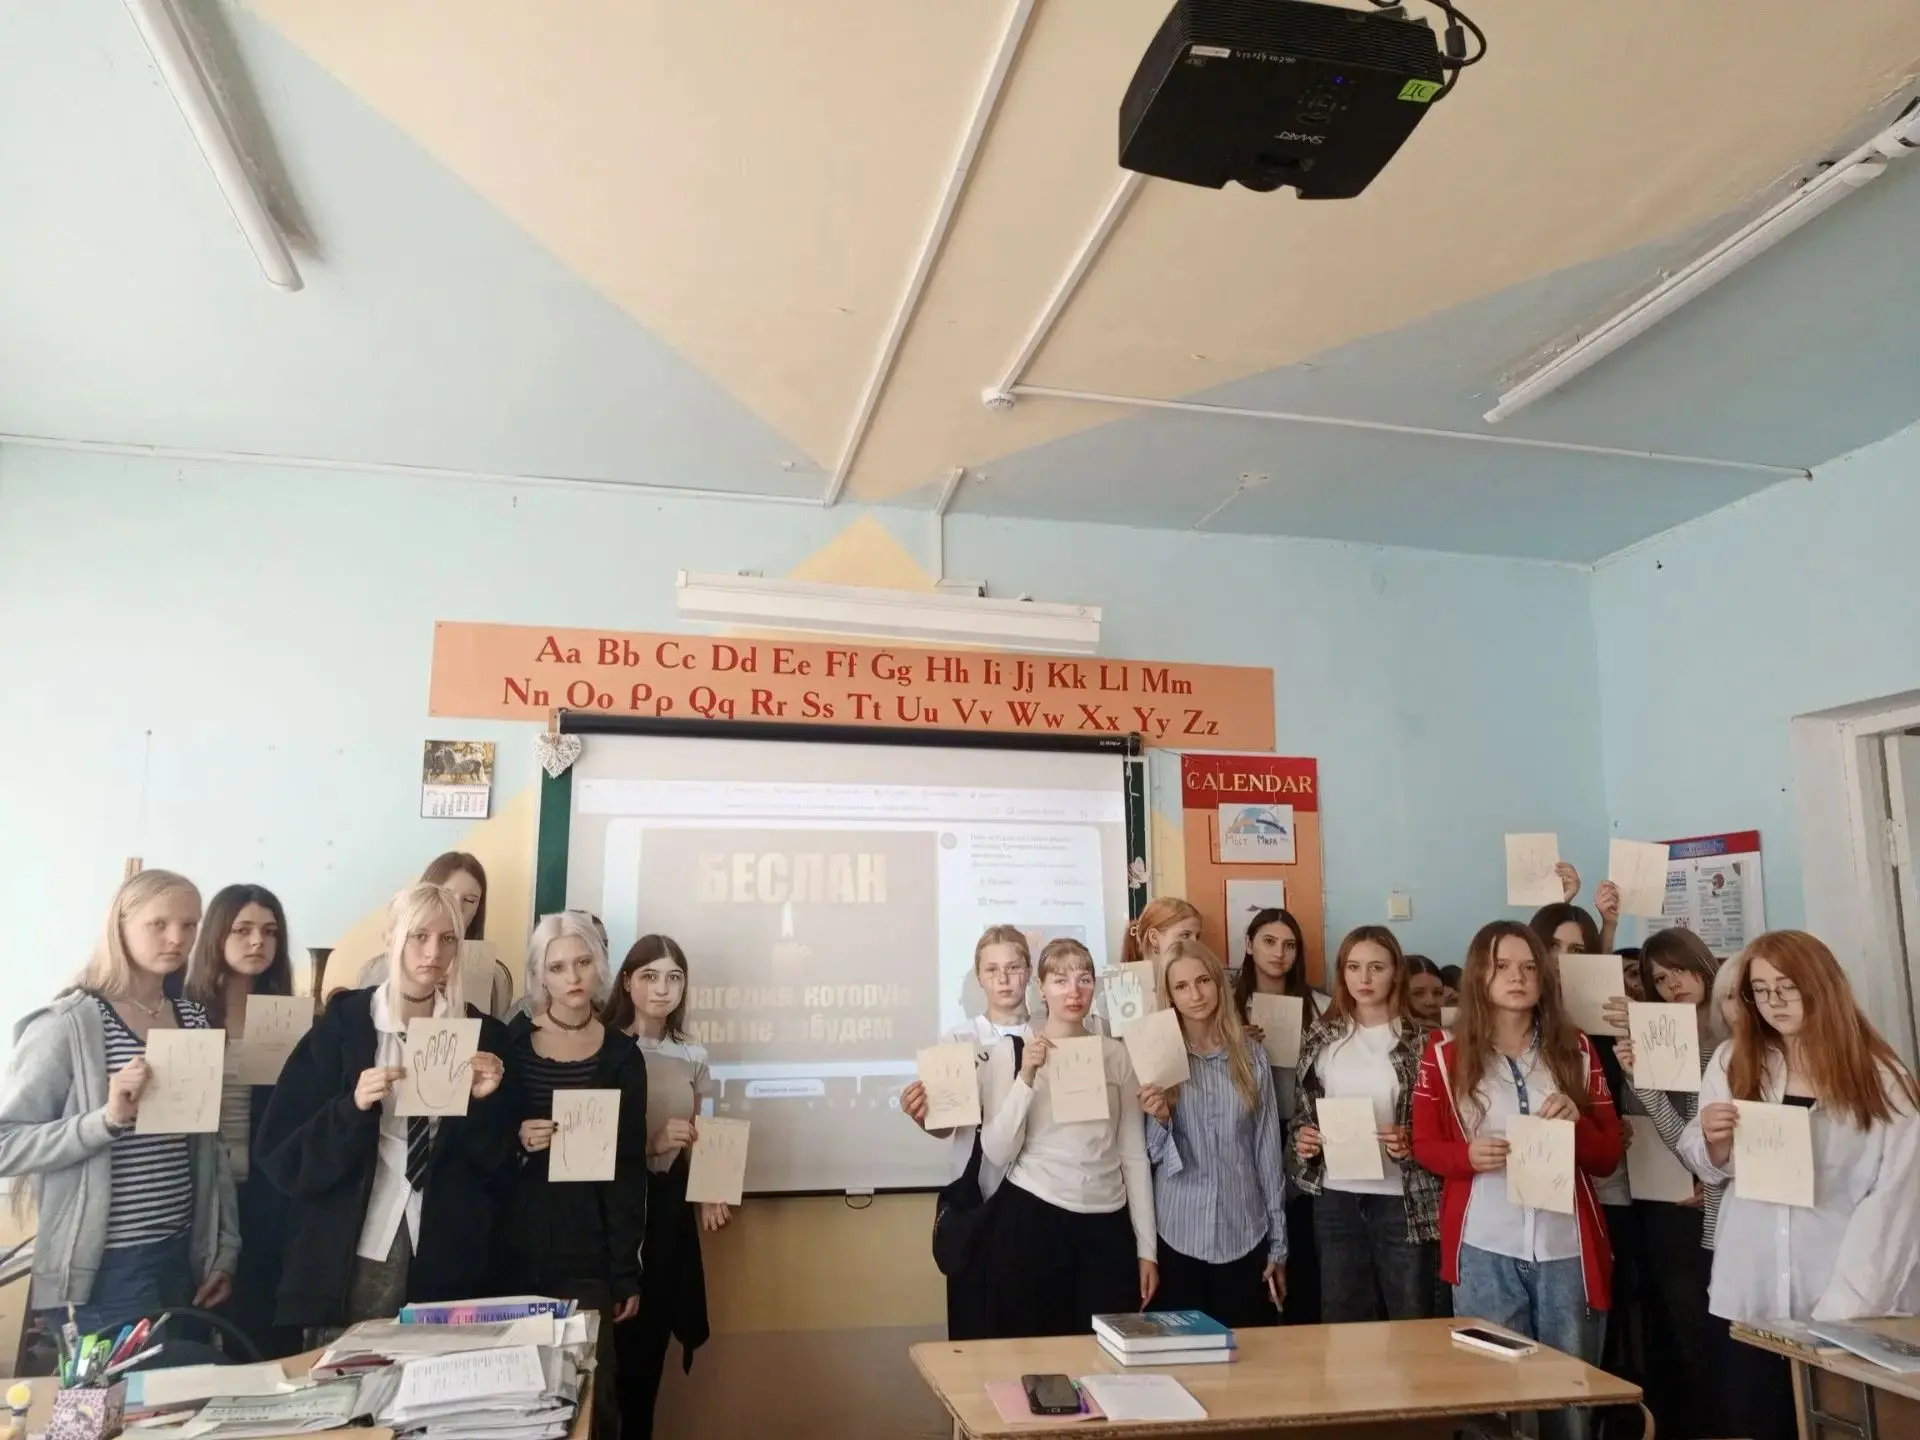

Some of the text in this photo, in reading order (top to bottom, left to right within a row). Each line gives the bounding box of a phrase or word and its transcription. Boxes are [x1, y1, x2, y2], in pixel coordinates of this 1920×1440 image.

[1274, 131, 1329, 145] SMART
[535, 635, 1193, 695] Aa Bb Cc Dd Ee Ff Gg Hh Ii Jj Kk Ll Mm
[503, 677, 1219, 738] Nn Oo Pp Qq Rr Ss Tt Uu Vv Ww Xx Yy Zz
[1186, 771, 1313, 794] CALENDAR
[697, 852, 888, 903] БЕСЛАН
[783, 1013, 895, 1044] будем
